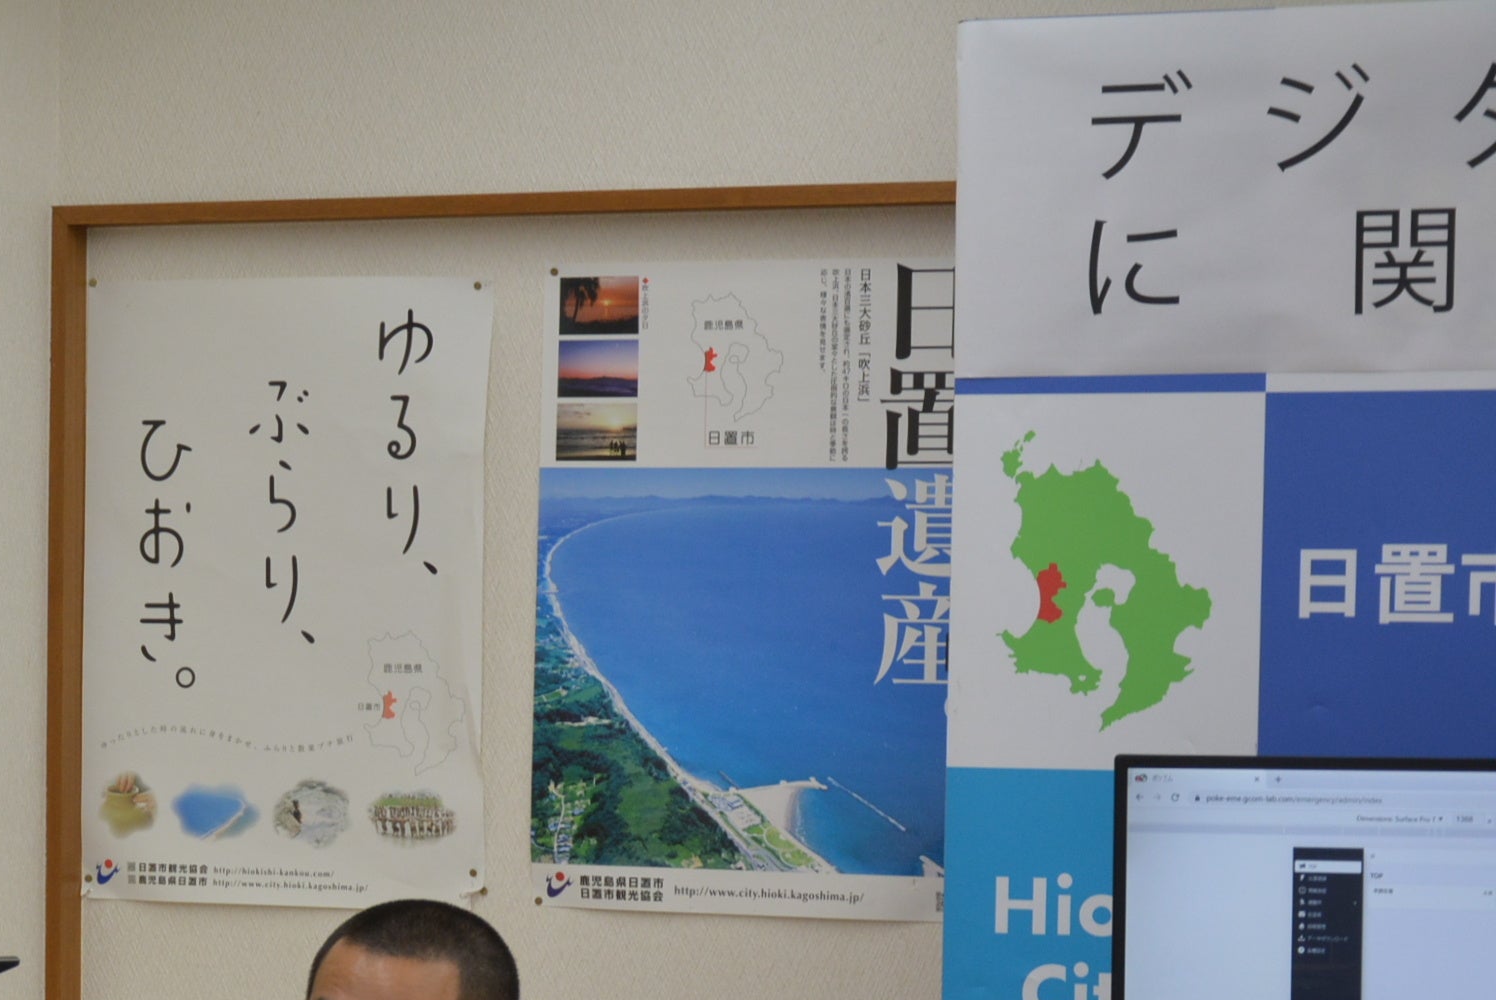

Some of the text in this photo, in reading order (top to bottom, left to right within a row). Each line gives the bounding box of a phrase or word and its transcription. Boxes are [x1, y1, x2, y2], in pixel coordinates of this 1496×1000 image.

[703, 319, 745, 331] 鹿児島県
[856, 267, 872, 402] 日本三大砂丘「吹上浜」
[377, 308, 439, 576] ゆるり、
[708, 430, 755, 446] 日置市
[248, 380, 316, 646] ぶらり、
[139, 418, 197, 690] ひおき。
[138, 862, 208, 874] 日置市観光協会
[138, 875, 369, 892] 鹿児島県日置市 http://www.city.hioki.kagoshima.jp/
[579, 875, 664, 889] 鹿児島県日置市
[579, 888, 664, 902] 日置市観光協会
[673, 885, 864, 904] http://www.city.hioki.kagoshima.jp/
